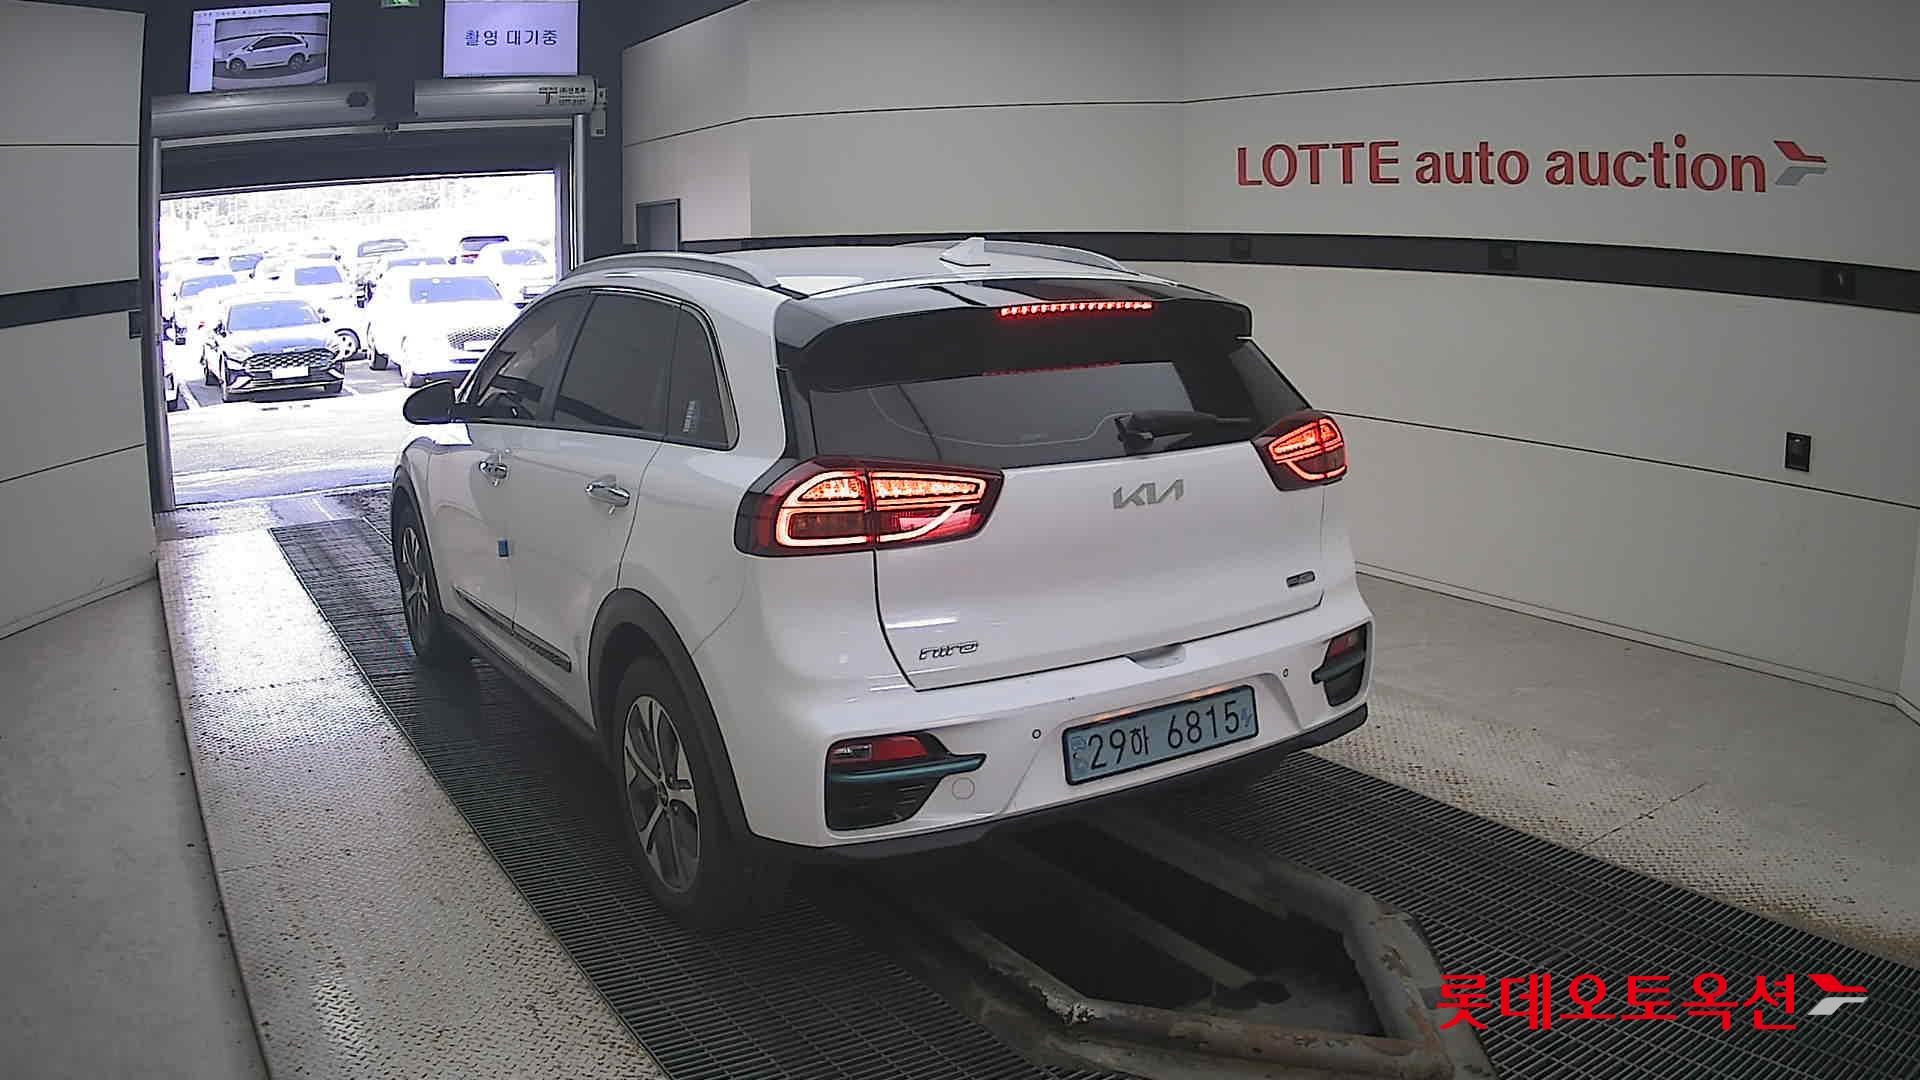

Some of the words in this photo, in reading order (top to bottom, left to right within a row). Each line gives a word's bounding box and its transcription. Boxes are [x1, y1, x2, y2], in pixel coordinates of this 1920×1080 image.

[506, 29, 558, 46] 대기중
[1236, 140, 1400, 187] LOTTE
[1415, 141, 1530, 185] auto
[1545, 134, 1768, 193] auction
[1113, 479, 1184, 509] KIA
[1088, 725, 1150, 770] 29하
[1167, 700, 1240, 749] 6815
